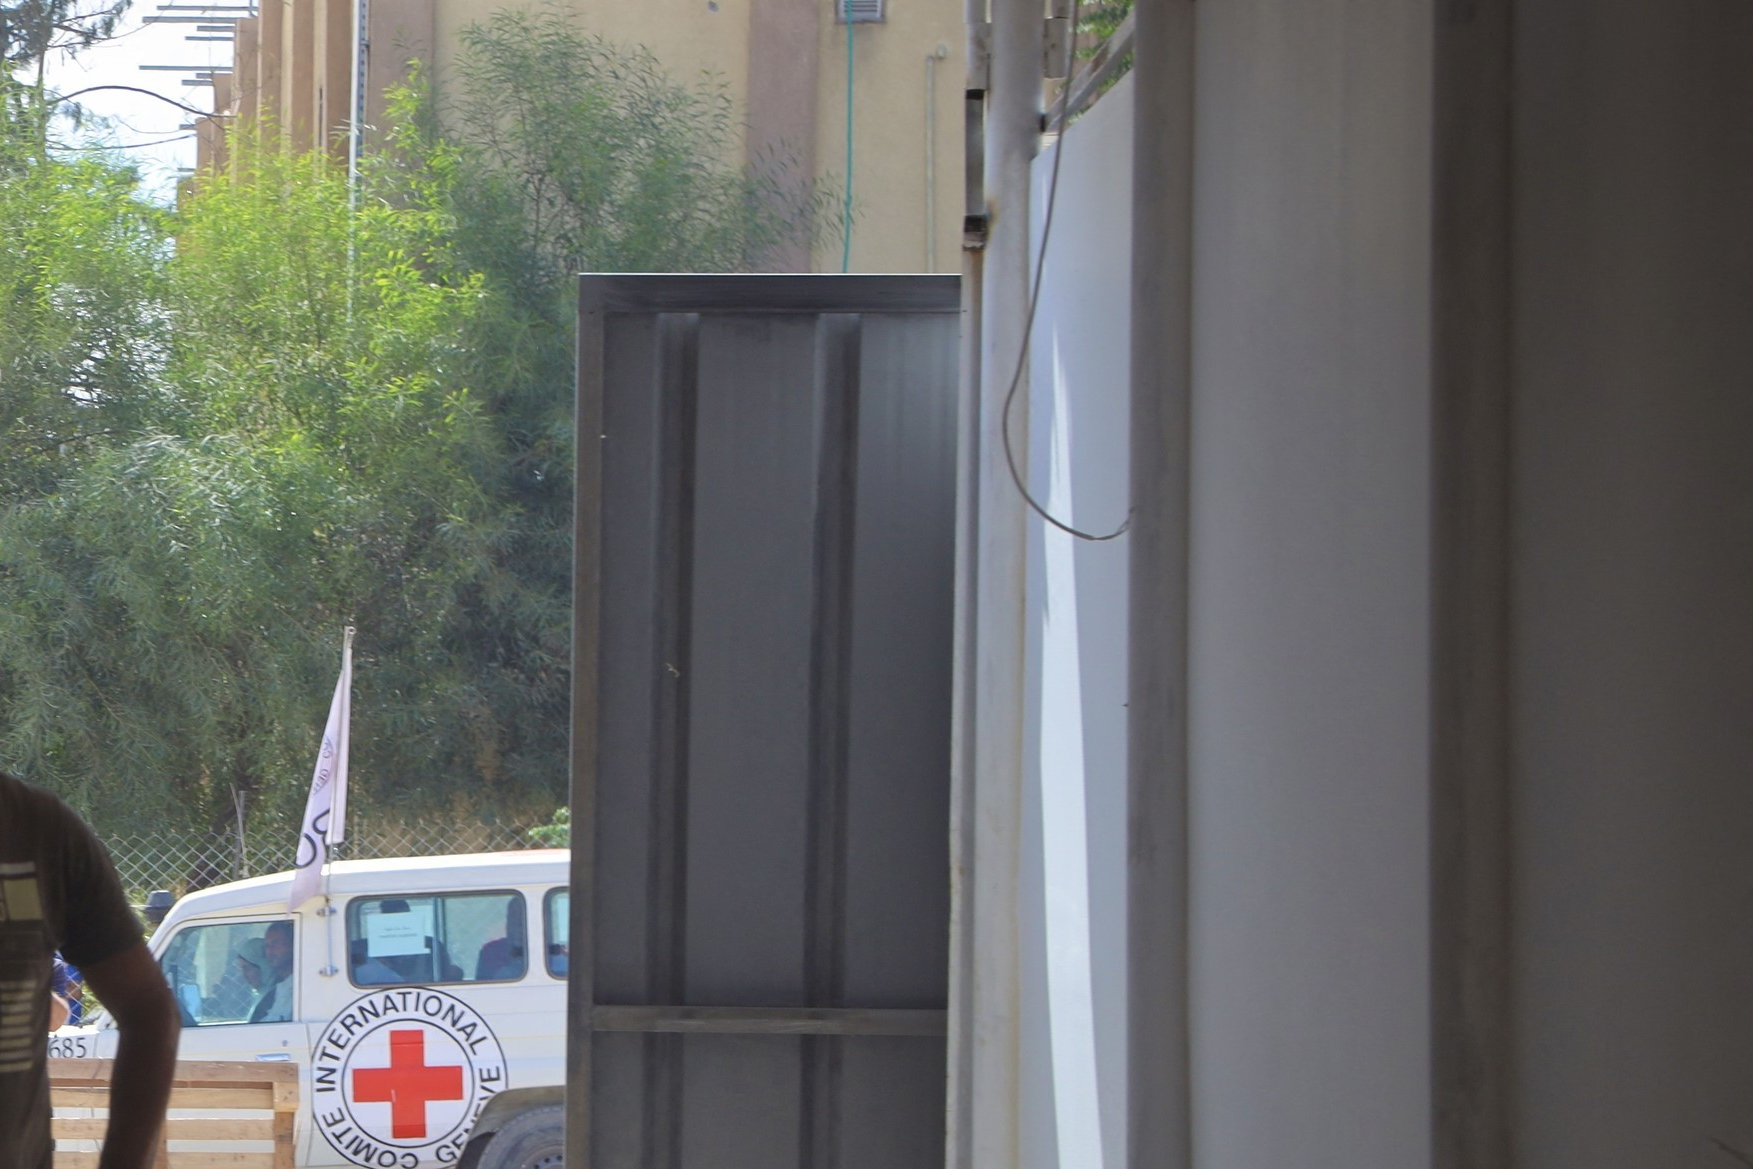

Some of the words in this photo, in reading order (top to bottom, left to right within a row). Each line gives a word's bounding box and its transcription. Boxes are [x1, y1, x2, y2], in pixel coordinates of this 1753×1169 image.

[48, 1037, 87, 1058] 685
[316, 991, 487, 1093] INTERNATIONAL
[322, 1107, 419, 1169] COMITE
